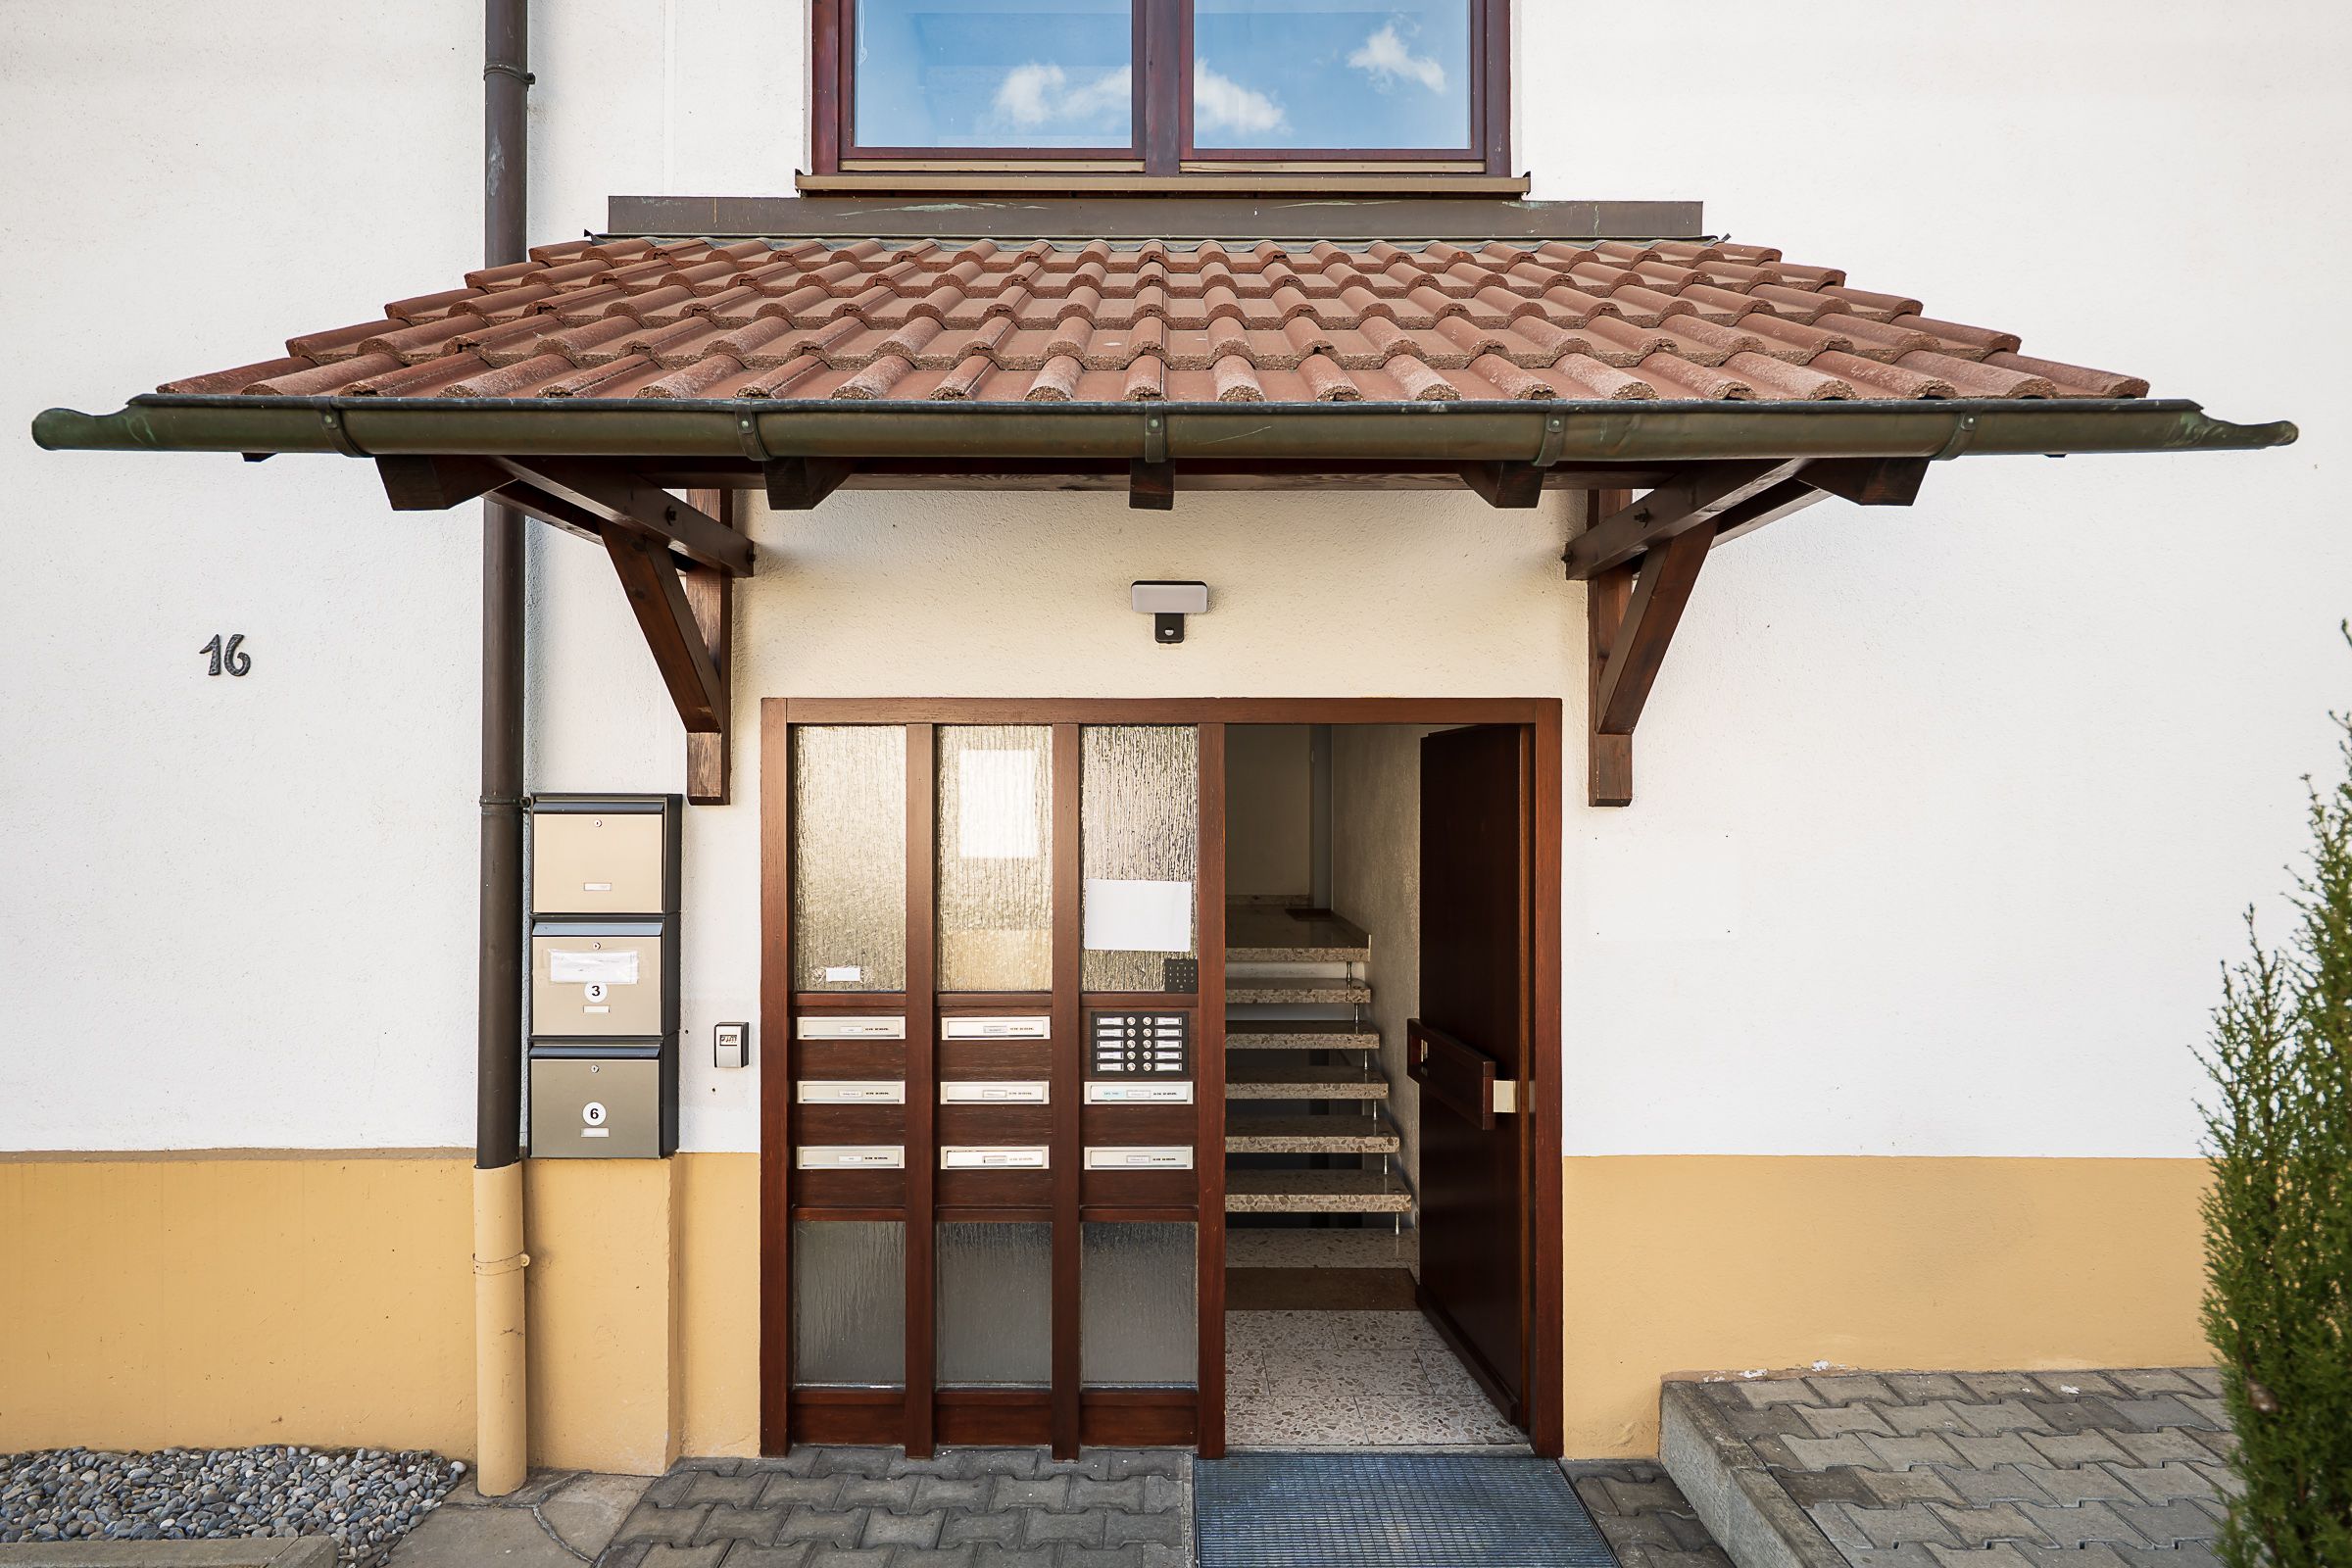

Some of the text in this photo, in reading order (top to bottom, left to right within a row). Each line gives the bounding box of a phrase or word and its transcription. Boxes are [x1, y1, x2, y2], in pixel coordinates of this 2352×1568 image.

[199, 634, 251, 676] 16
[591, 985, 601, 997] 3
[590, 1107, 600, 1119] 6
